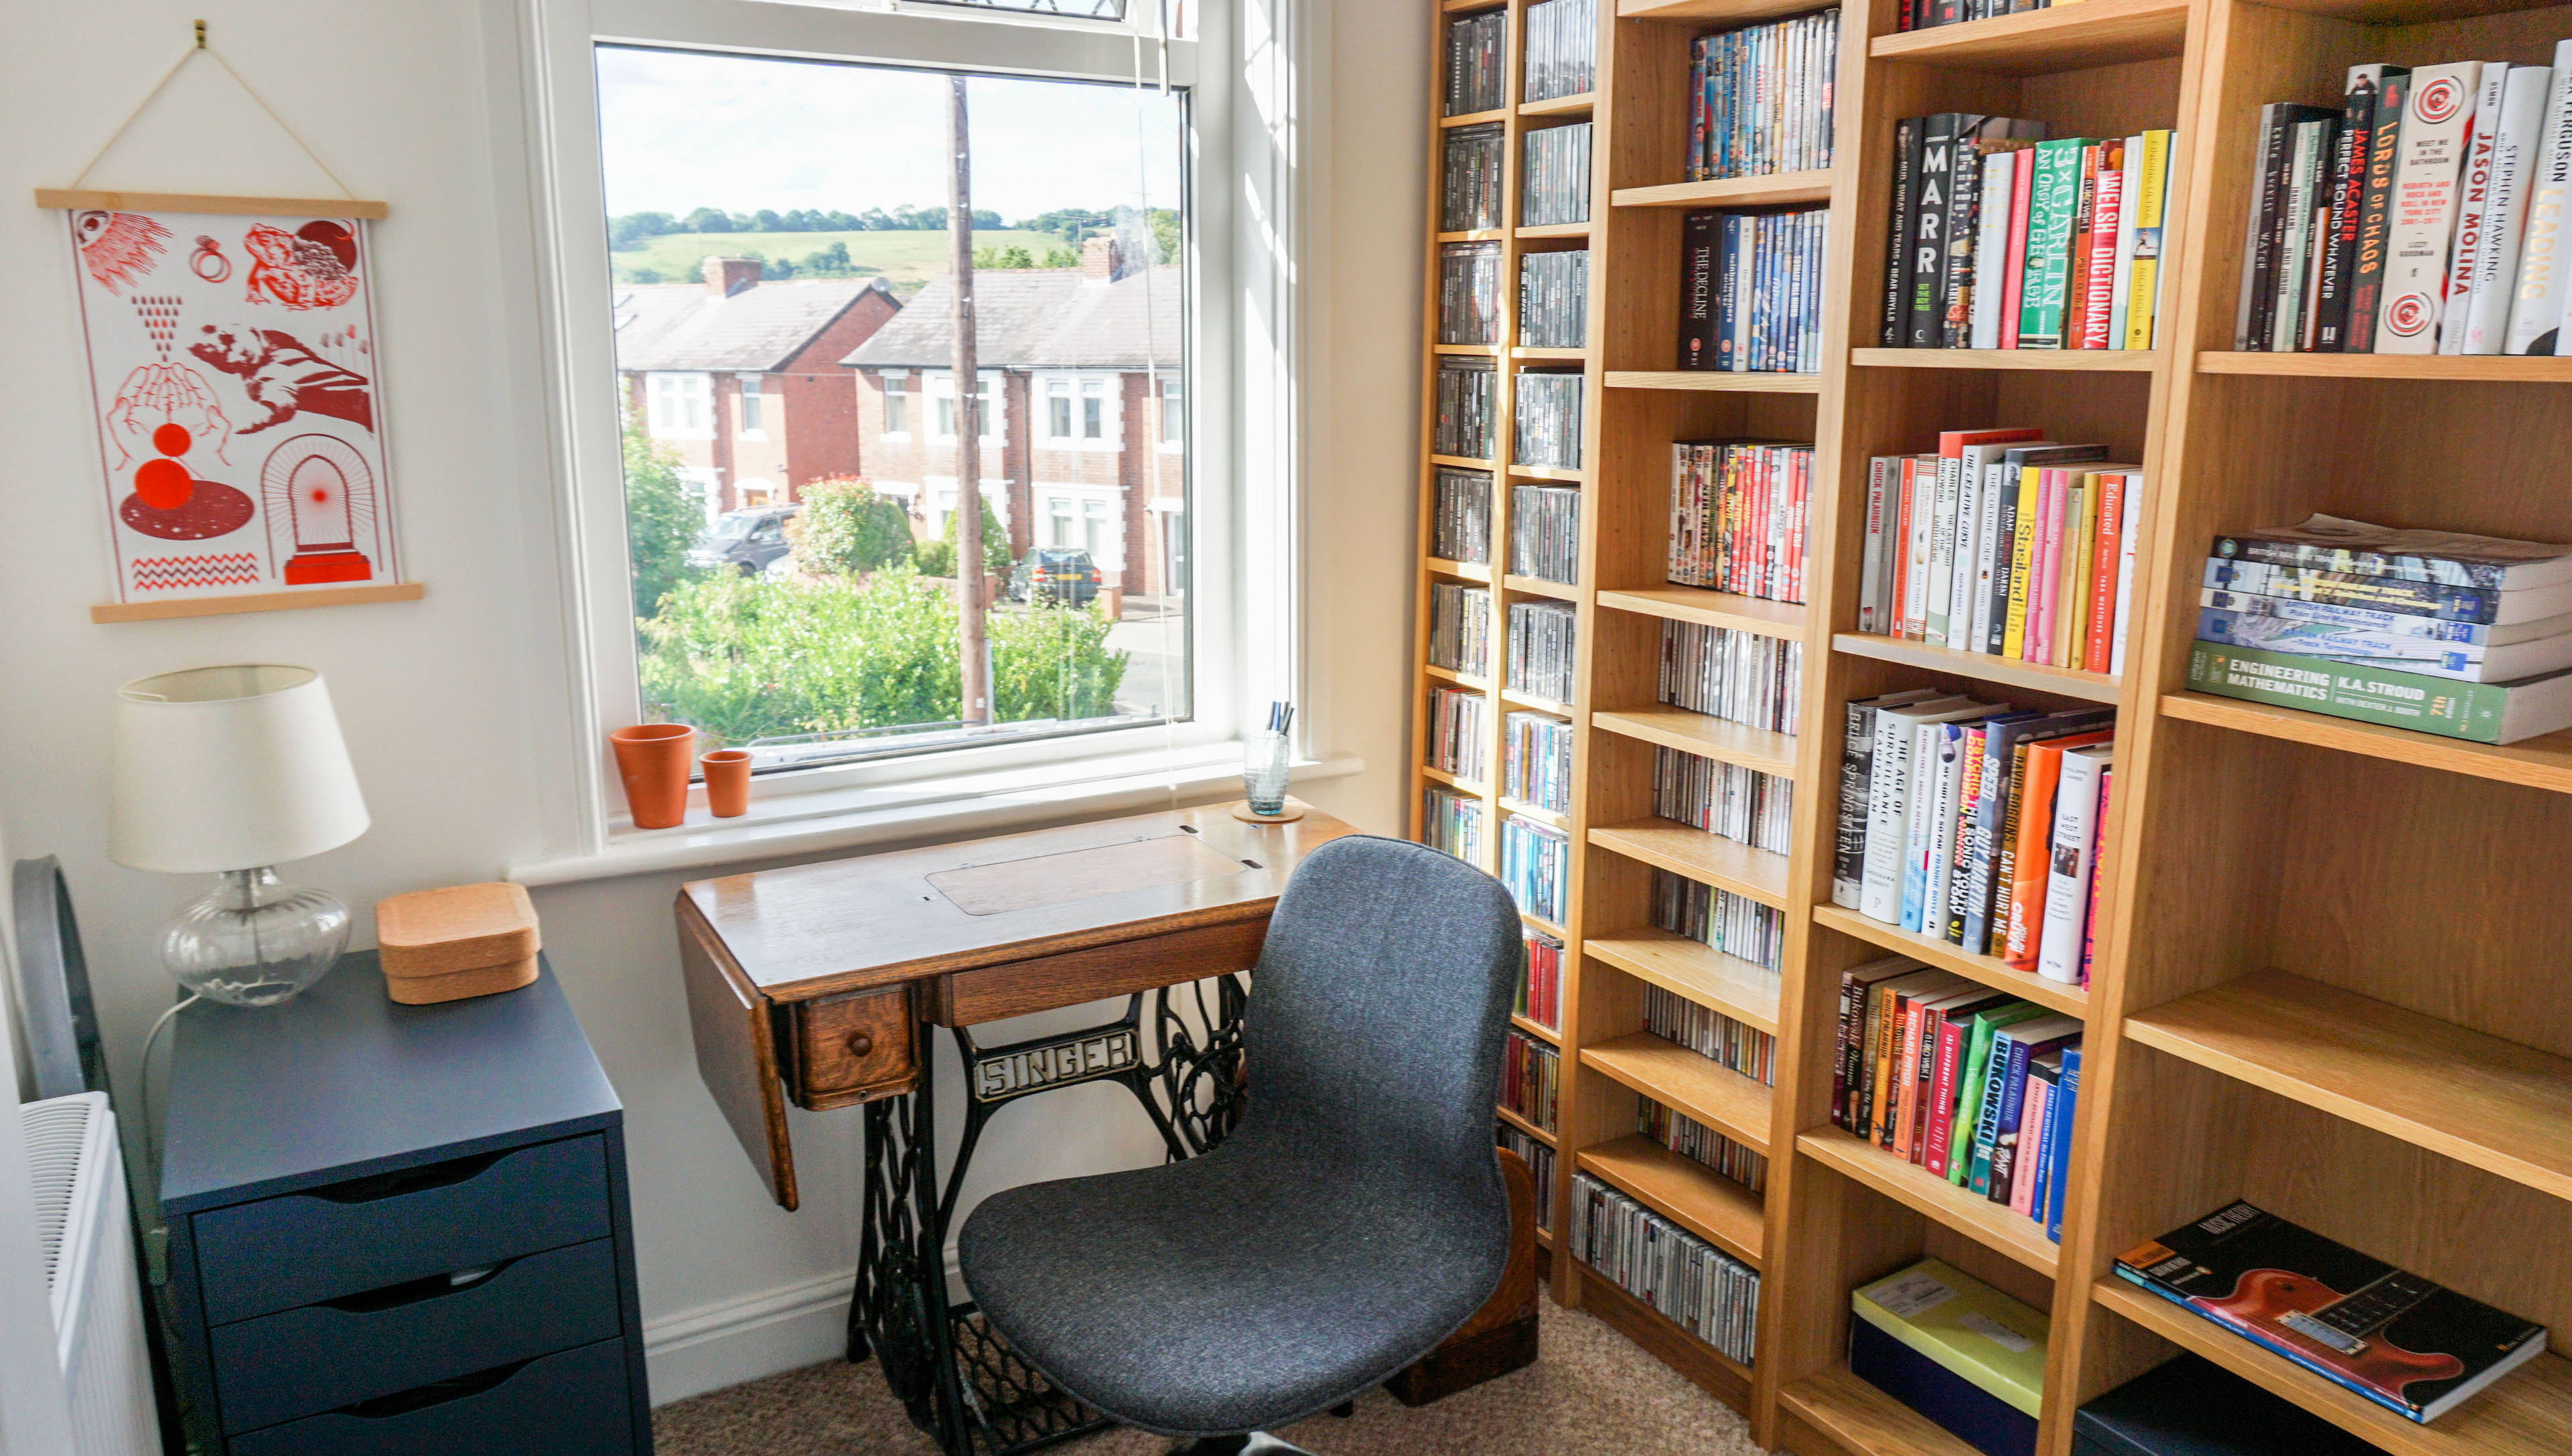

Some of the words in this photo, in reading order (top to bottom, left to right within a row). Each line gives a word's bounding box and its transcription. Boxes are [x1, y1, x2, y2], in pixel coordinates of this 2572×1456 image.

[2038, 148, 2054, 169] AN
[2336, 129, 2354, 179] PERFECT
[2348, 129, 2369, 175] JAMES
[2372, 122, 2399, 188] LORDS
[2468, 133, 2493, 203] JASON
[2497, 145, 2518, 207] STEPHEN
[1896, 184, 1906, 212] SWEAT
[1917, 145, 1948, 273] MARR
[2080, 179, 2094, 230] BUKOWSKI
[2094, 175, 2123, 234] WELSH
[2330, 183, 2348, 230] SOUND
[2340, 179, 2361, 241] ACASTER
[2370, 194, 2385, 209] OF
[1894, 214, 1904, 230] AND
[1696, 246, 1710, 269] THE
[1892, 233, 1902, 260] TEARS
[2359, 213, 2382, 275] CHAOS
[2452, 213, 2480, 296] MOLINA
[2484, 214, 2507, 282] HAWKING
[2520, 189, 2564, 301] LEADING
[1889, 269, 1899, 289] BEAR
[2320, 234, 2339, 299] WHATEVER
[1695, 271, 1709, 319] DECLINE
[1886, 291, 1897, 322] GRYLLS
[2084, 246, 2116, 344] DICTIONARY
[1872, 461, 1885, 488] CHUCK
[1947, 461, 1958, 501] CHARLES
[1966, 453, 1975, 470] THE
[1989, 473, 1997, 490] THE
[1869, 491, 1883, 535] PALAHNIUK
[1962, 473, 1974, 516] CREATIVE
[1985, 492, 1996, 534] CULTURE
[2102, 484, 2119, 536] Educated
[1959, 521, 1970, 550] CURVE
[2005, 505, 2015, 531] ADAM
[1983, 536, 1993, 563] CODE
[2011, 524, 2033, 601] Stasiland
[1999, 567, 2010, 596] DARSKI
[2099, 576, 2108, 593] TARA
[2095, 596, 2106, 633] WESTOVER
[2226, 672, 2328, 701] MATHEMATICS
[2228, 658, 2332, 686] ENGINEERING
[2337, 676, 2365, 692] K.A.
[2366, 680, 2426, 701] STROUD
[2429, 695, 2447, 717] 7th
[1846, 712, 1862, 757] BRUCE
[1896, 739, 1909, 763] THE
[1871, 730, 1884, 814] CAPITALISM
[1880, 723, 1897, 826] SURVEILLANCE
[1895, 768, 1906, 796] AGE
[1959, 735, 1975, 814] CONFUSION
[1970, 737, 1985, 798] PSYCHIC
[1980, 753, 2001, 802] SPEED
[2010, 755, 2025, 793] DAVID
[1838, 763, 1859, 853] SPRINGSTEEN
[1893, 800, 1904, 816] OF
[2004, 795, 2021, 843] GOGGINS
[1961, 827, 1976, 869] SONIC
[1975, 825, 1993, 857] GUY
[1999, 849, 2015, 883] CAN'T
[1948, 868, 1962, 915] STORY
[1956, 872, 1971, 916] YOUTH
[1968, 857, 1990, 918] MARTIN
[1995, 885, 2009, 916] HURT
[1992, 917, 2007, 936] ME
[1847, 986, 1863, 1046] Bukowski
[1883, 993, 1894, 1019] CHUCK
[1892, 1013, 1907, 1055] Bukowski
[1905, 1010, 1917, 1054] RICHARD
[978, 1032, 1134, 1096] SINGER
[1902, 1055, 1914, 1086] PRYOR
[1942, 1045, 1953, 1086] DIFFERENT
[2010, 1046, 2025, 1074] CHUCK
[1937, 1088, 1948, 1114] THINGS
[1979, 1040, 2009, 1141] BUKOWSKI
[2003, 1075, 2021, 1122] PALAHNIUK
[1993, 1146, 2011, 1179] RANT
[2198, 1215, 2236, 1236] MUSIC
[2221, 1203, 2261, 1225] THEORY
